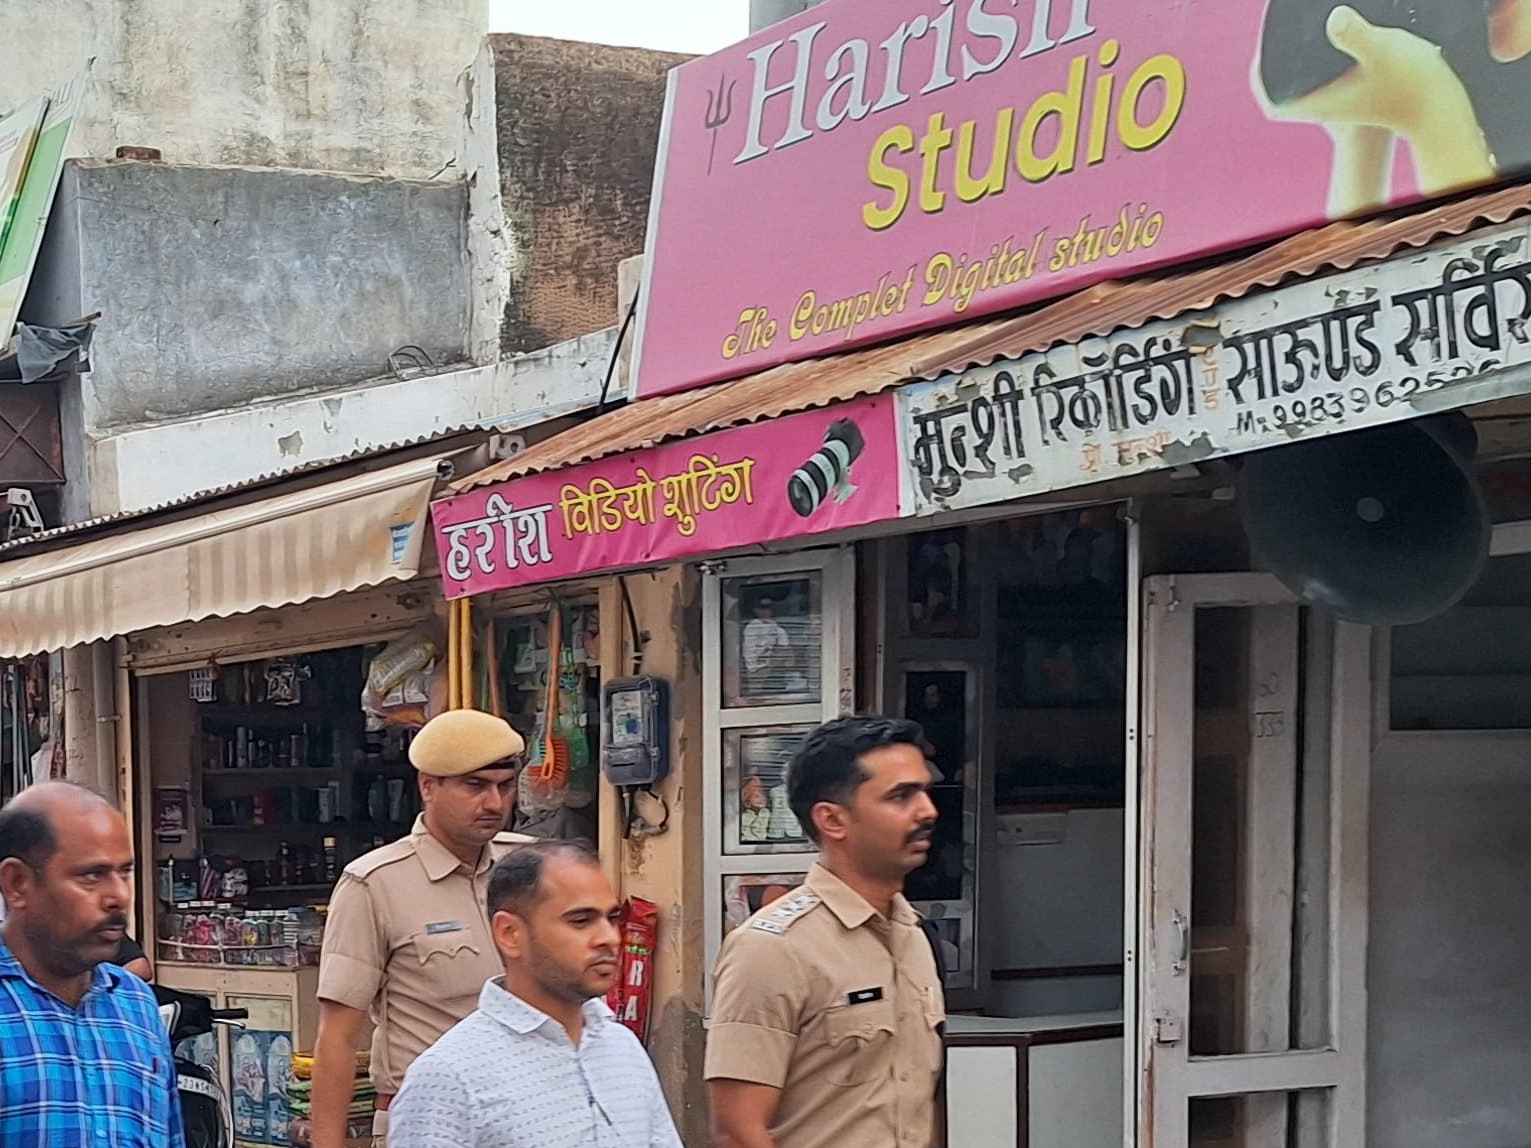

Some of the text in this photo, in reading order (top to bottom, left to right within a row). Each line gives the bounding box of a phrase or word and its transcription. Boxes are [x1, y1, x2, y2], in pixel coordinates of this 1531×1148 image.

[861, 39, 1186, 231] Studio
[721, 203, 1165, 359] The Complet Digital studio
[441, 453, 756, 580] हरीश विडियो शुटिंग
